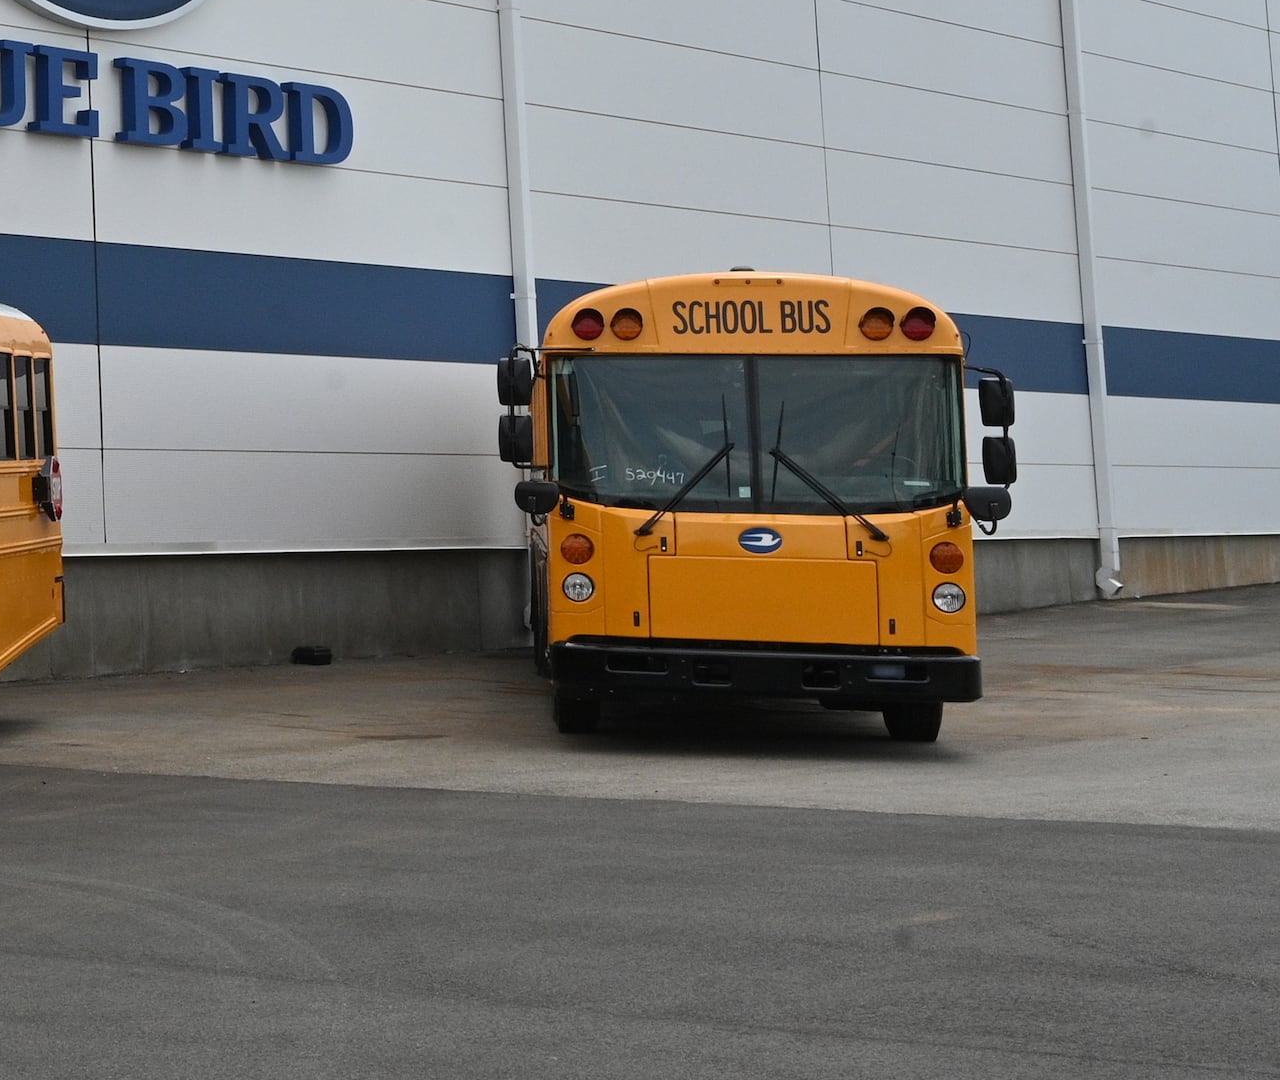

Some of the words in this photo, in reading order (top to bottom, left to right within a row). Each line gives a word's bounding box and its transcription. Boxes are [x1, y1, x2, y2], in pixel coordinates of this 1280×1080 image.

[113, 57, 354, 165] BIRD
[672, 300, 773, 335] SCHOOL
[780, 299, 831, 334] BUS
